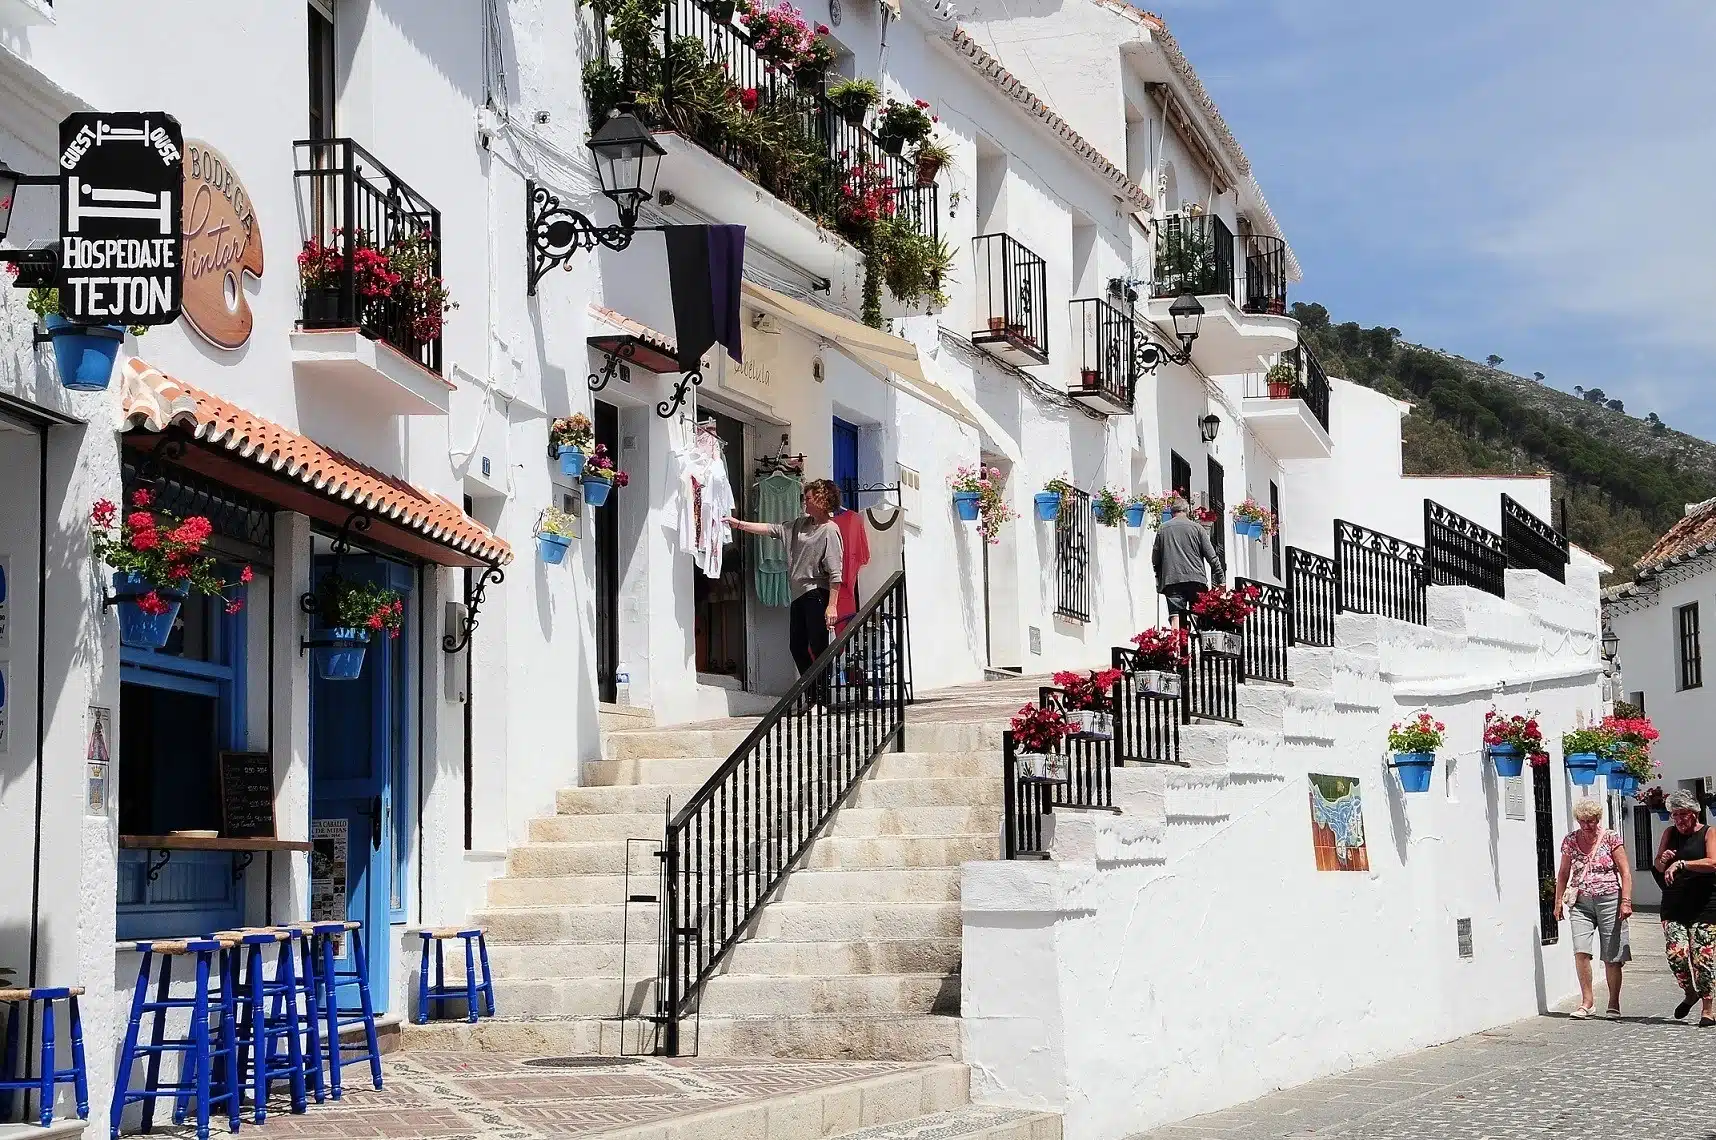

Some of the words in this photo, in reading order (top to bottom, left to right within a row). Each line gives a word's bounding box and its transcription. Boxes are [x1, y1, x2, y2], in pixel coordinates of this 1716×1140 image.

[60, 125, 97, 170] GUEST
[189, 147, 254, 243] BODEGA
[62, 236, 175, 269] HOSPEDAJE
[68, 276, 172, 315] TEJON
